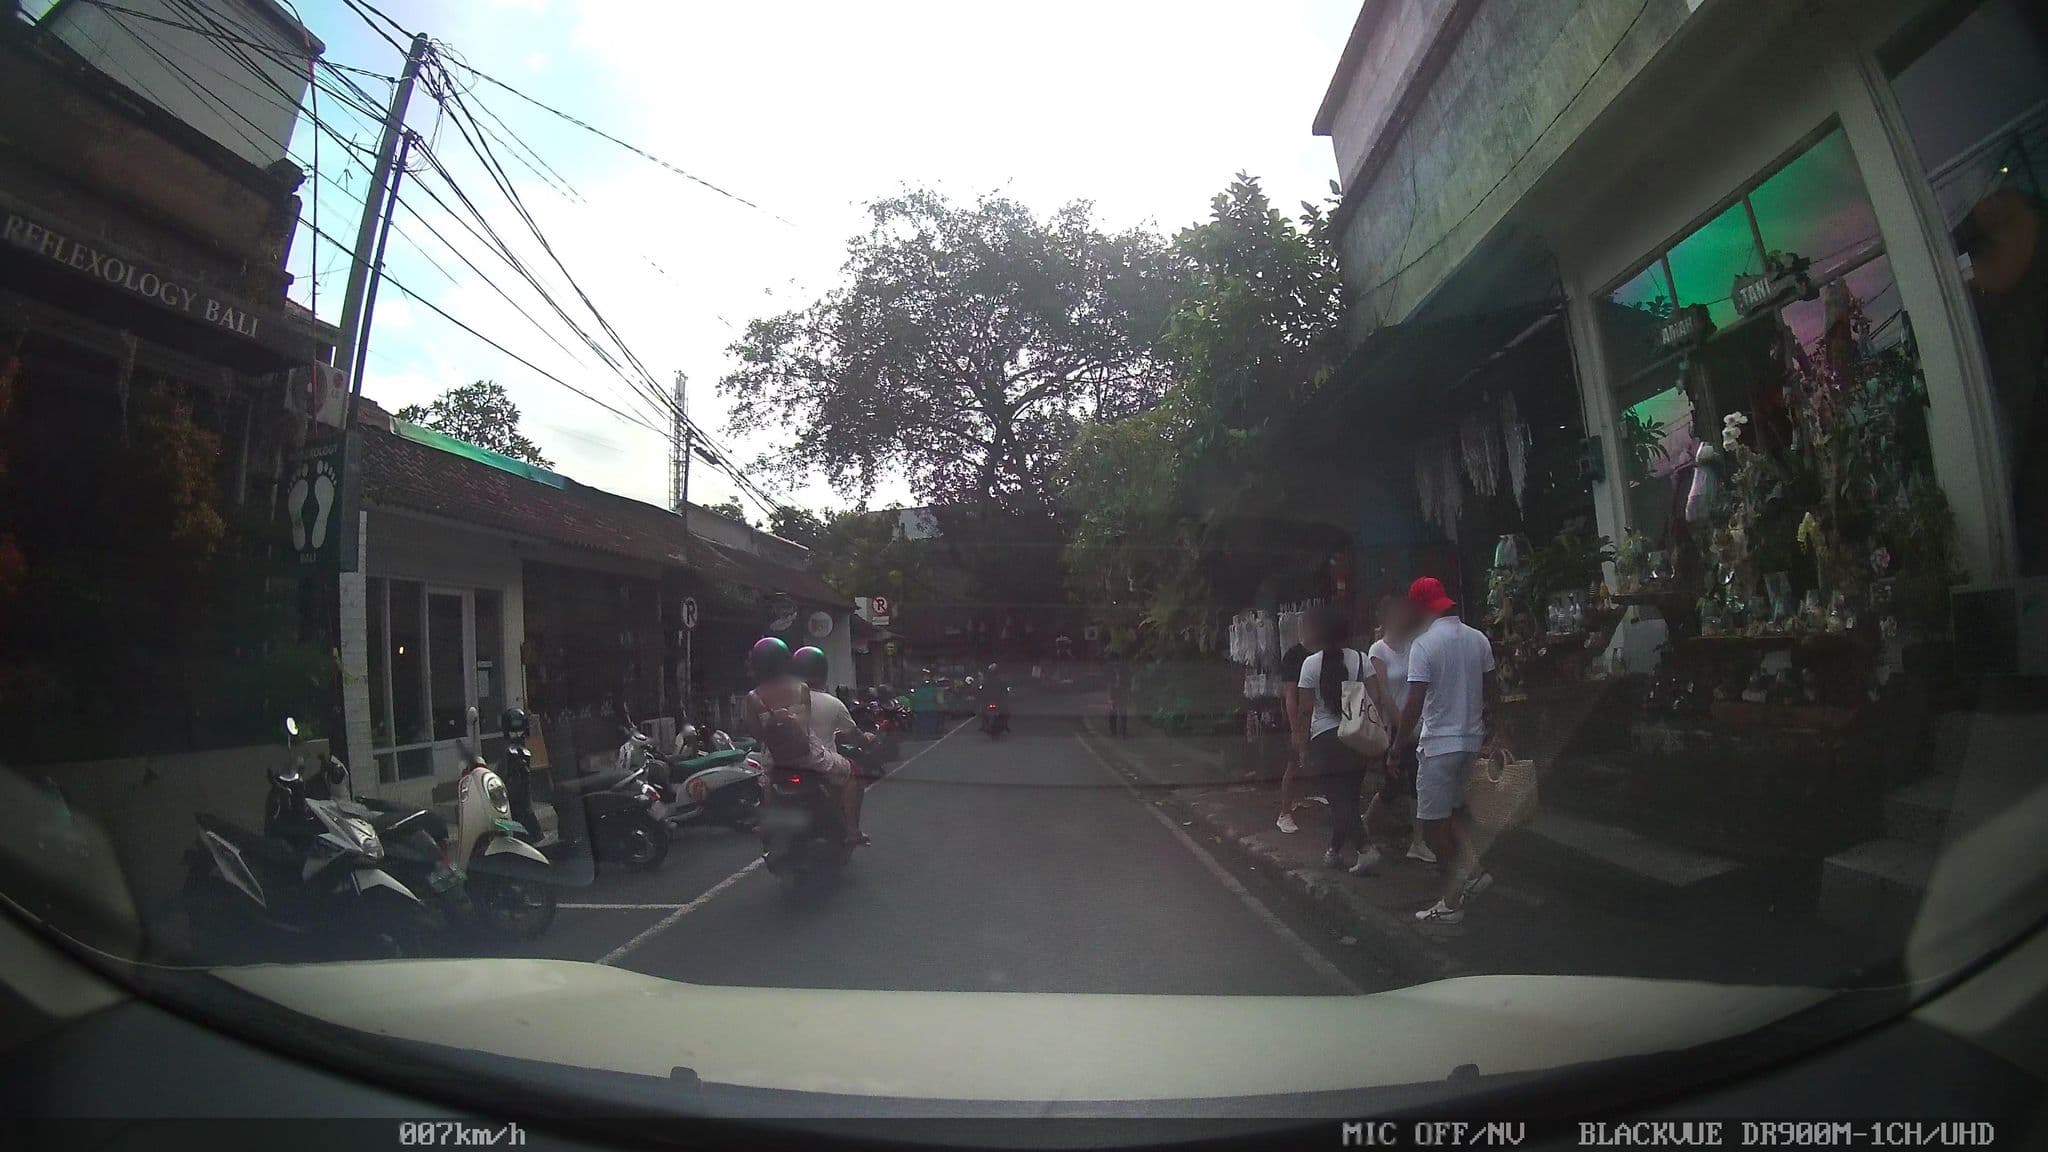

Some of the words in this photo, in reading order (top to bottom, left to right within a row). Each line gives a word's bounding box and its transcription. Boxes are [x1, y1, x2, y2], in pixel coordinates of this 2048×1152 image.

[3, 215, 197, 312] REFLEXOLOGY
[204, 299, 259, 338] BALI
[1739, 277, 1771, 305] TANI
